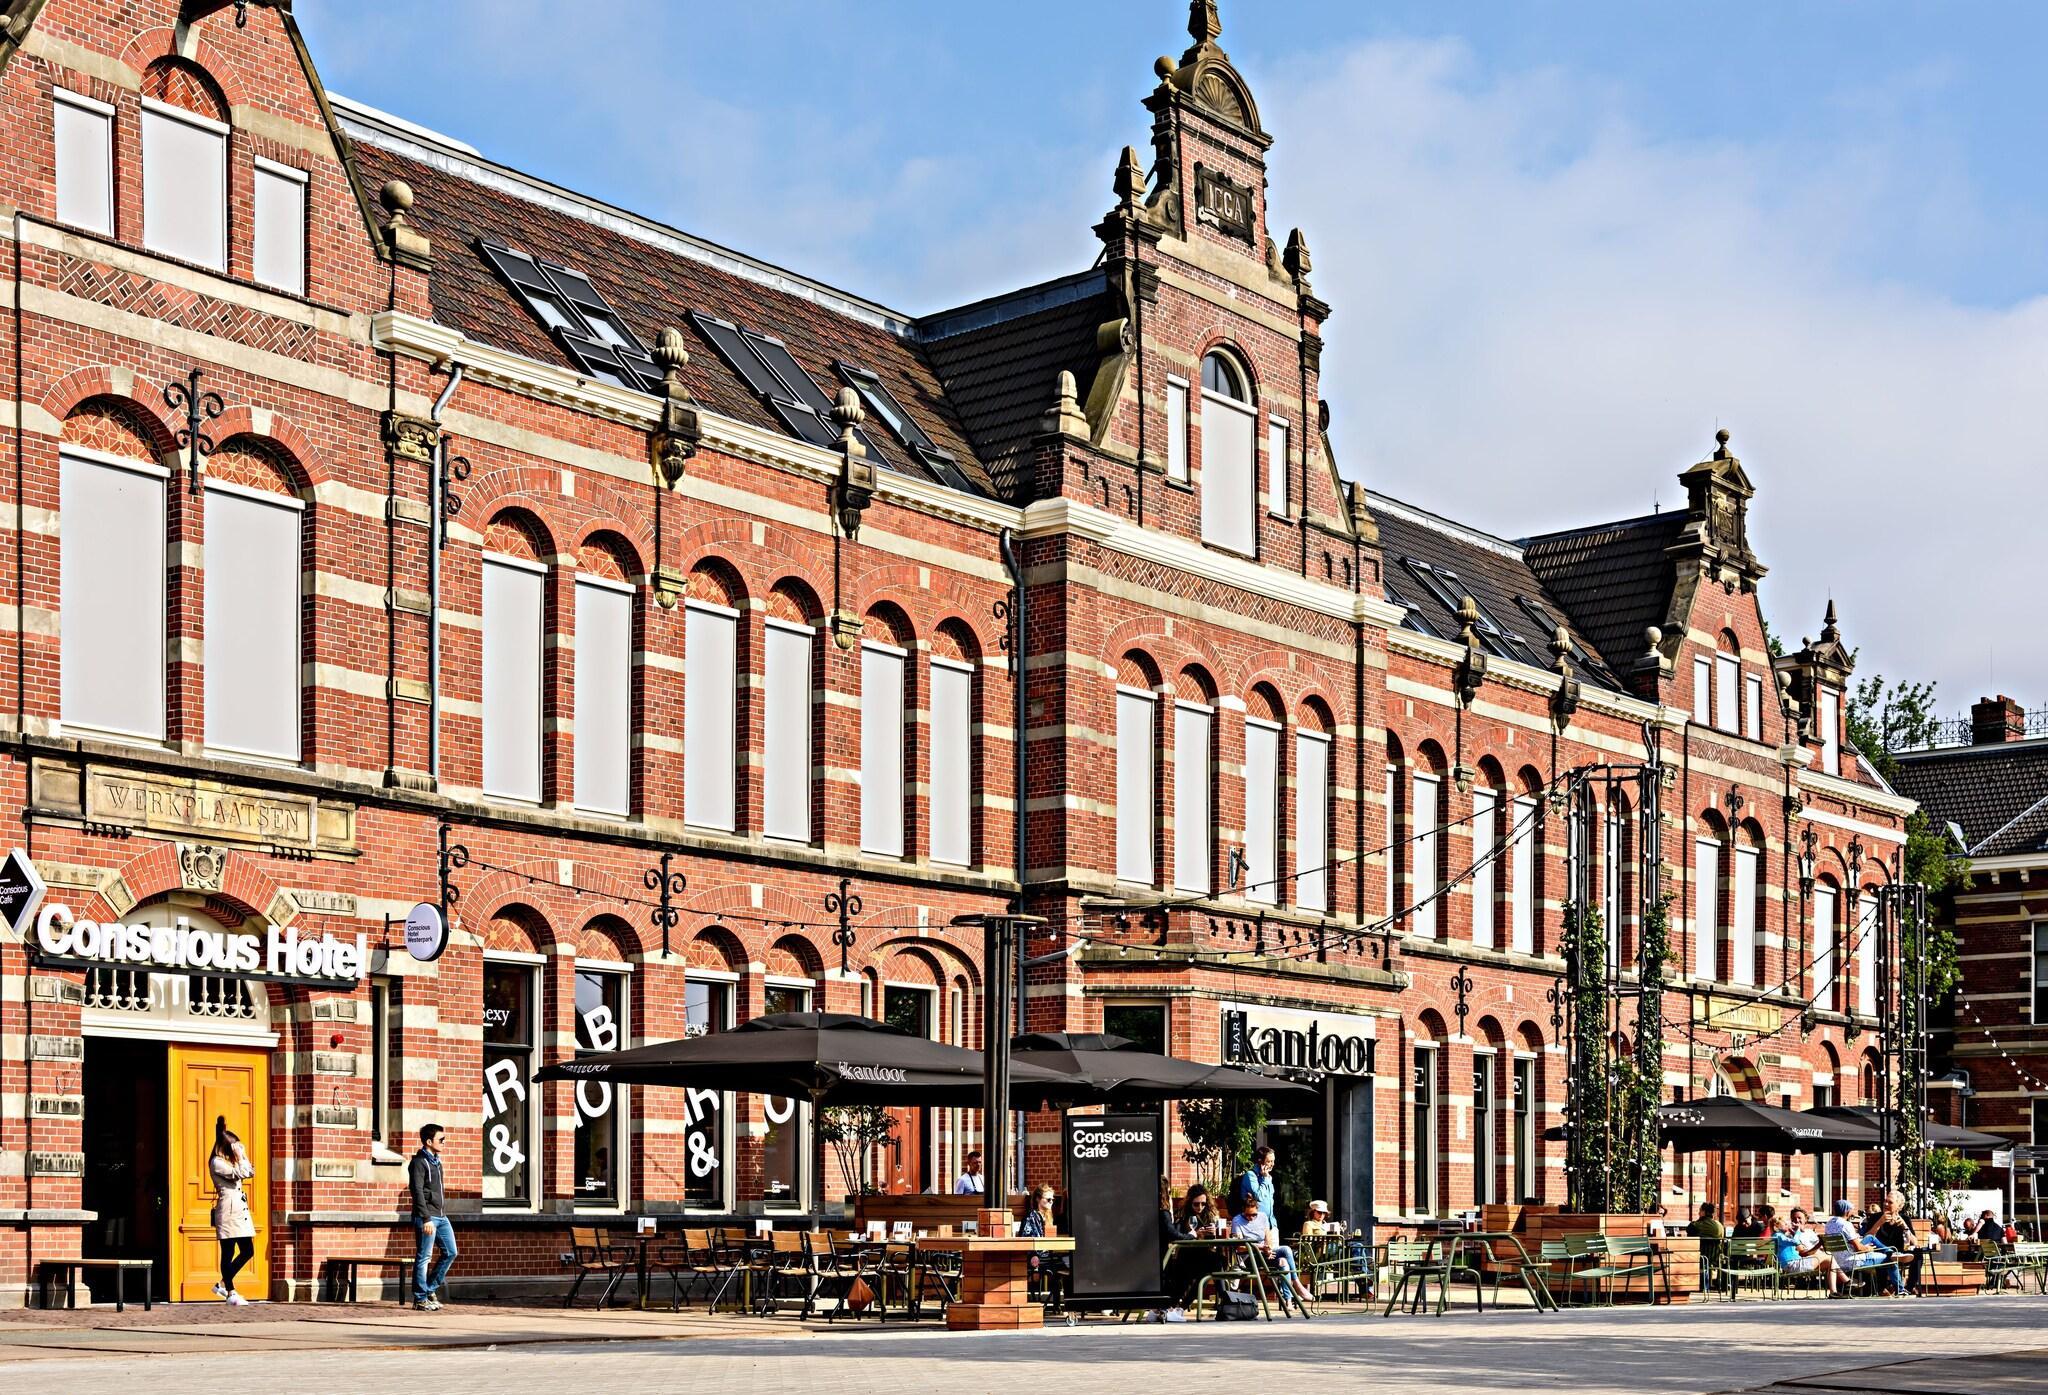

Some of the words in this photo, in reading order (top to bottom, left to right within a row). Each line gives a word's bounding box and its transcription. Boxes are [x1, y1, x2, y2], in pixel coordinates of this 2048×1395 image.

[104, 784, 299, 832] WERKPLAATSEN
[0, 886, 28, 894] Conscious
[37, 902, 261, 971] Conscious
[266, 924, 367, 979] Hotel
[1228, 1011, 1380, 1073] kantoor
[1232, 1021, 1241, 1052] BAR
[489, 1124, 526, 1173] &
[687, 1131, 720, 1178] &
[1073, 1129, 1153, 1143] Conscious
[1073, 1144, 1109, 1158] Café
